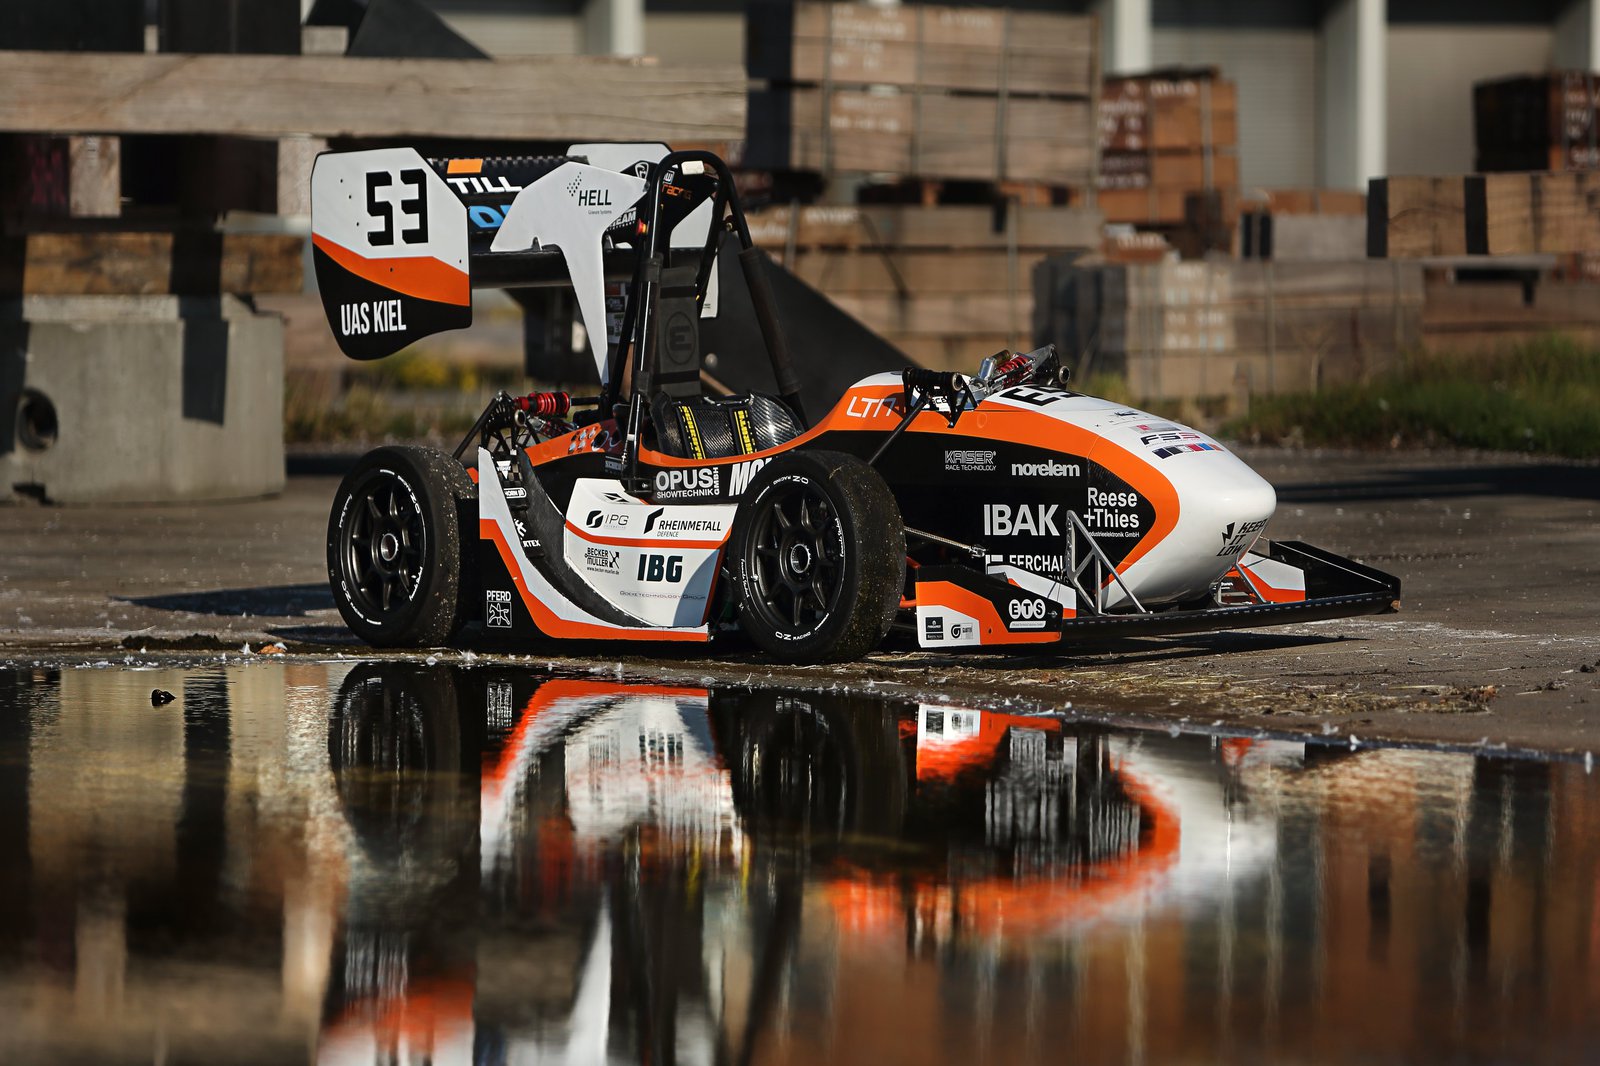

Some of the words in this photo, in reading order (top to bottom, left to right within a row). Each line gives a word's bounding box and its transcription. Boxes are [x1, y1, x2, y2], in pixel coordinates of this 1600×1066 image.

[446, 176, 523, 194] TILL
[578, 189, 612, 206] HELL
[366, 168, 429, 246] 53
[341, 302, 370, 337] UAS
[373, 299, 407, 332] KIEL
[1011, 459, 1080, 477] norelem
[656, 467, 714, 491] OPUS
[656, 488, 714, 499] SHOWTECHNIK
[1087, 487, 1138, 507] Reese
[604, 514, 630, 526] IPG
[658, 519, 722, 531] RHEINMETALL
[983, 504, 1060, 536] IBAK
[1229, 534, 1246, 546] IT
[587, 547, 609, 558] BECKER
[637, 554, 683, 582] IBG
[486, 590, 511, 602] PFERD
[1011, 601, 1044, 617] ETS
